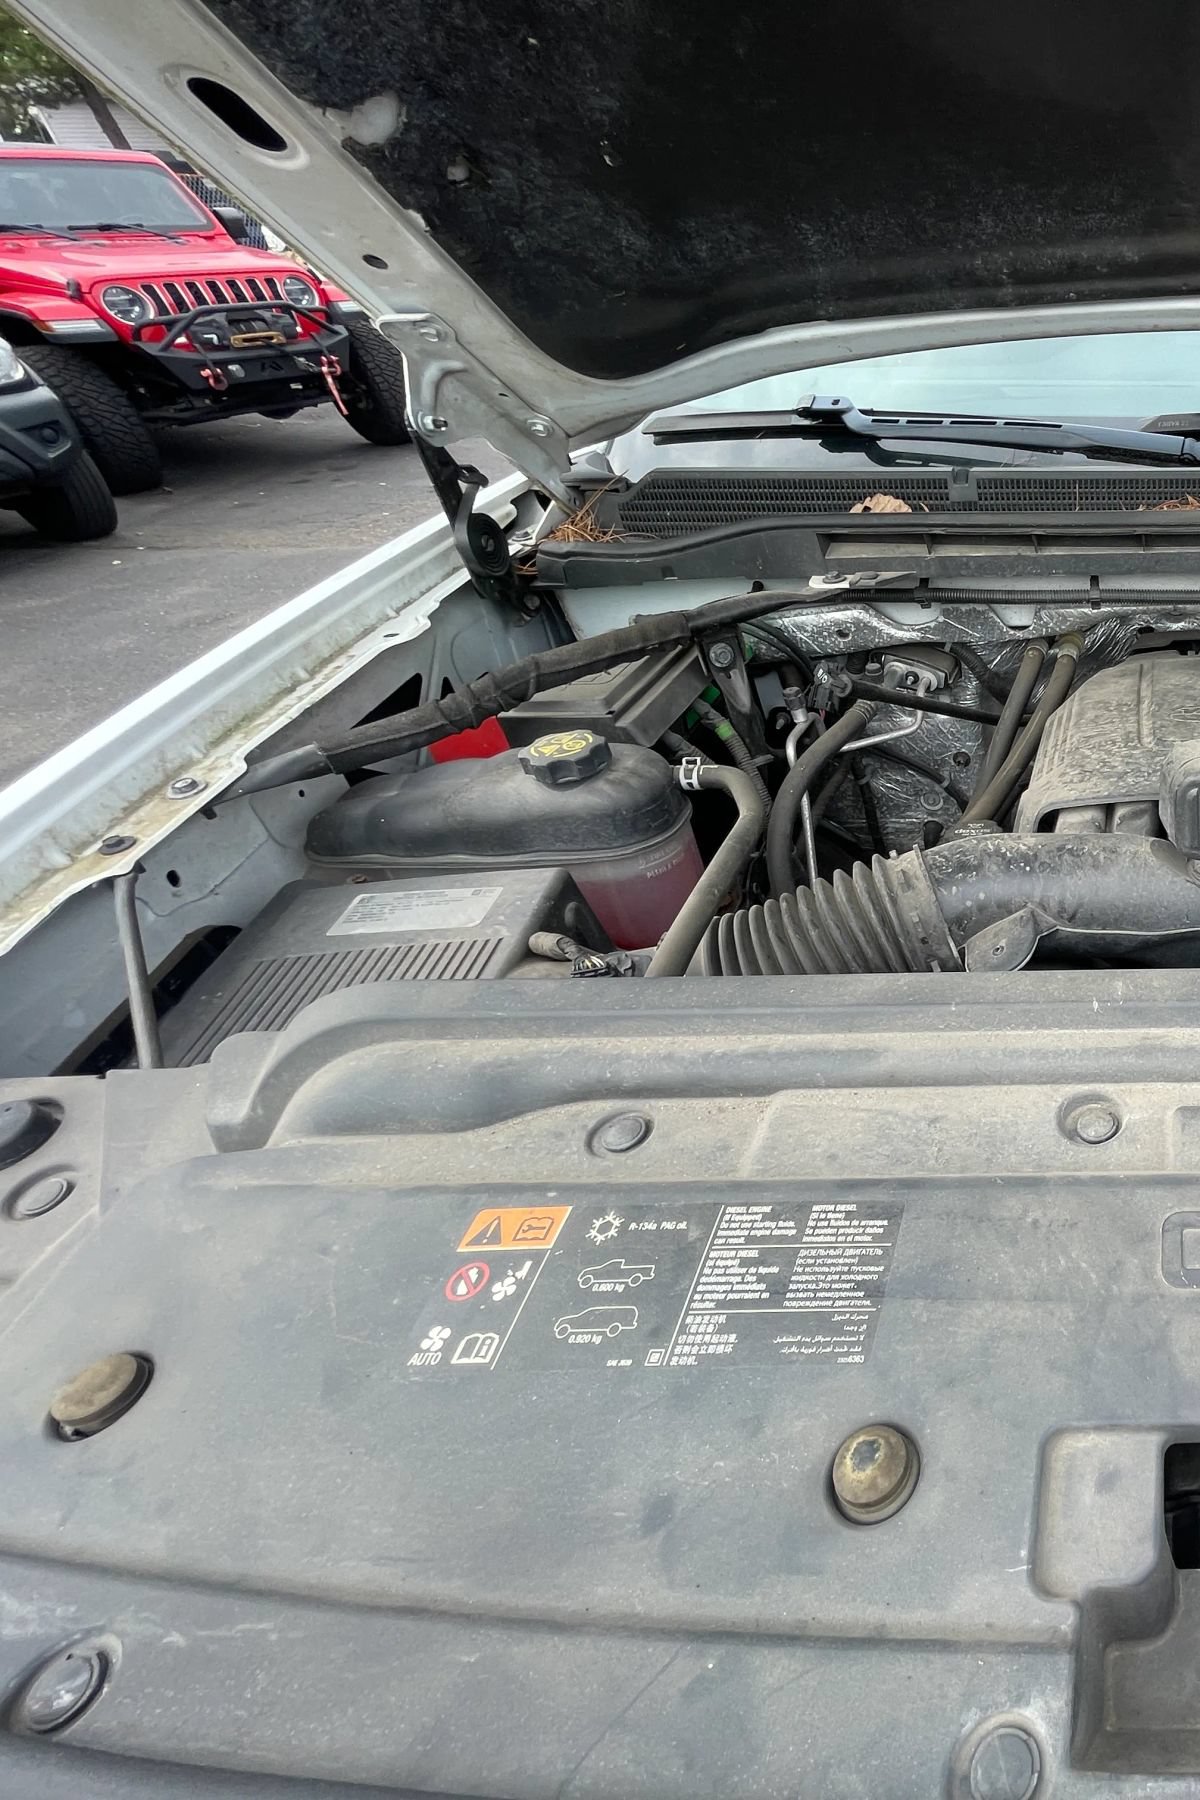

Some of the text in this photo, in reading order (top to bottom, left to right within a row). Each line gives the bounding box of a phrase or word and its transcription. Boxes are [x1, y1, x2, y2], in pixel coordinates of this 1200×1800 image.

[628, 1222, 657, 1230] R-134a
[660, 1222, 676, 1230] PAG
[749, 1229, 771, 1237] engine
[838, 1227, 864, 1235] producir
[709, 1250, 736, 1258] MOTEUR
[798, 1248, 883, 1256] ДИЗЕЛЬНЫЙ ДВИГАТЕЛЬ
[816, 1257, 858, 1265] установлен)
[712, 1268, 725, 1276] pas
[757, 1266, 779, 1275] liquide
[744, 1274, 757, 1282] Des
[614, 1284, 625, 1292] kg
[696, 1284, 732, 1292] dommages
[726, 1291, 761, 1300] pourraient
[783, 1300, 833, 1308] повреждение
[568, 1334, 602, 1345] 0.920 kg
[407, 1351, 442, 1366] AUTO
